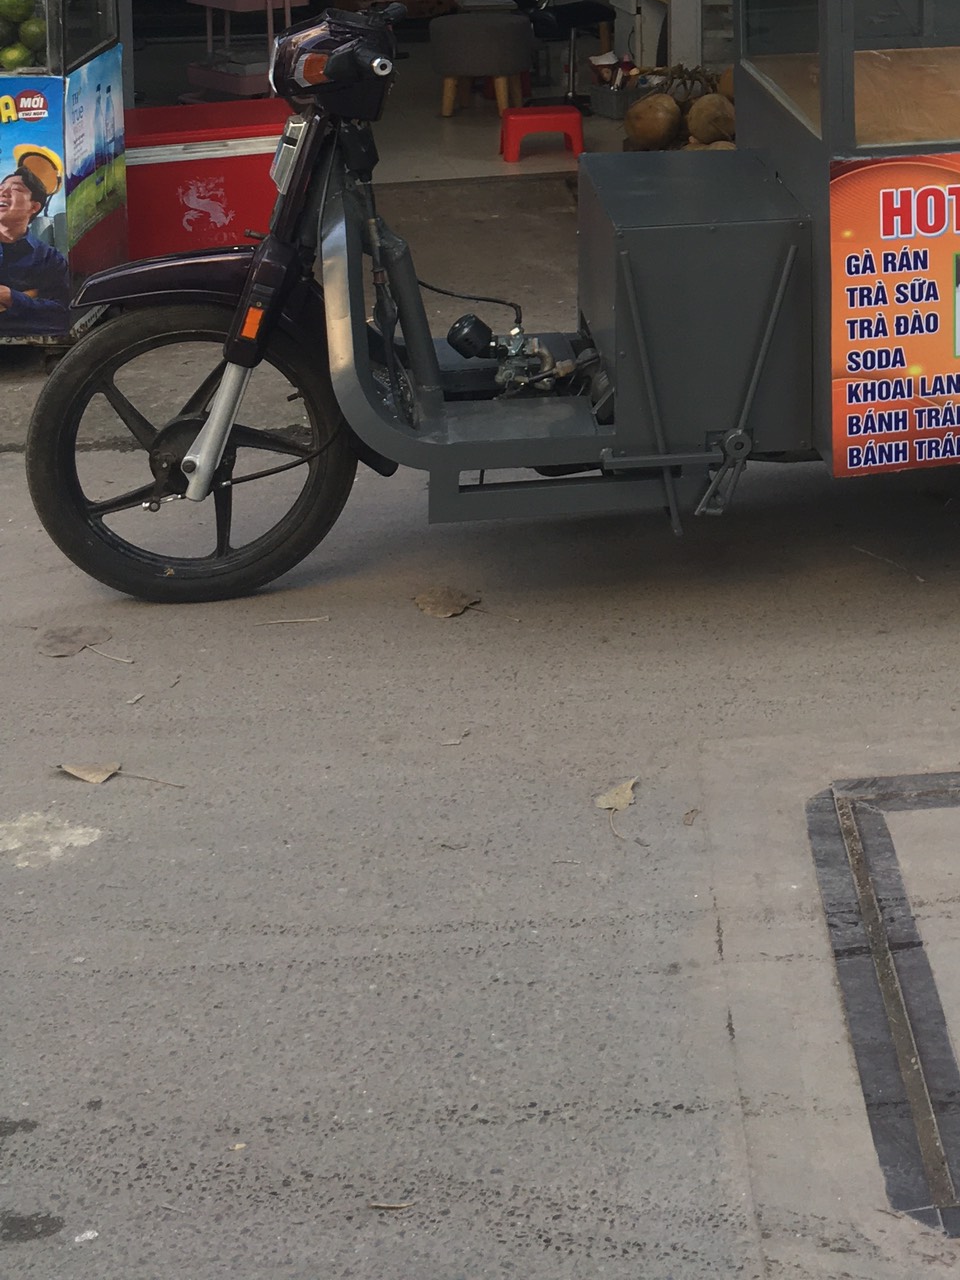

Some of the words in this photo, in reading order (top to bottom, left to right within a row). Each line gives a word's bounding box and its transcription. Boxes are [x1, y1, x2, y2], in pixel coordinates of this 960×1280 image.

[846, 248, 876, 276] GÀ
[882, 246, 929, 273] RÁN
[846, 280, 889, 308] TRÀ
[894, 277, 940, 304] SỮA
[846, 312, 889, 340] TRÀ
[894, 309, 940, 336] ĐÀO
[847, 347, 906, 373] SODA
[847, 377, 913, 404] KHOAI
[847, 408, 908, 436] BÁNH
[847, 440, 908, 468] BÁNH
